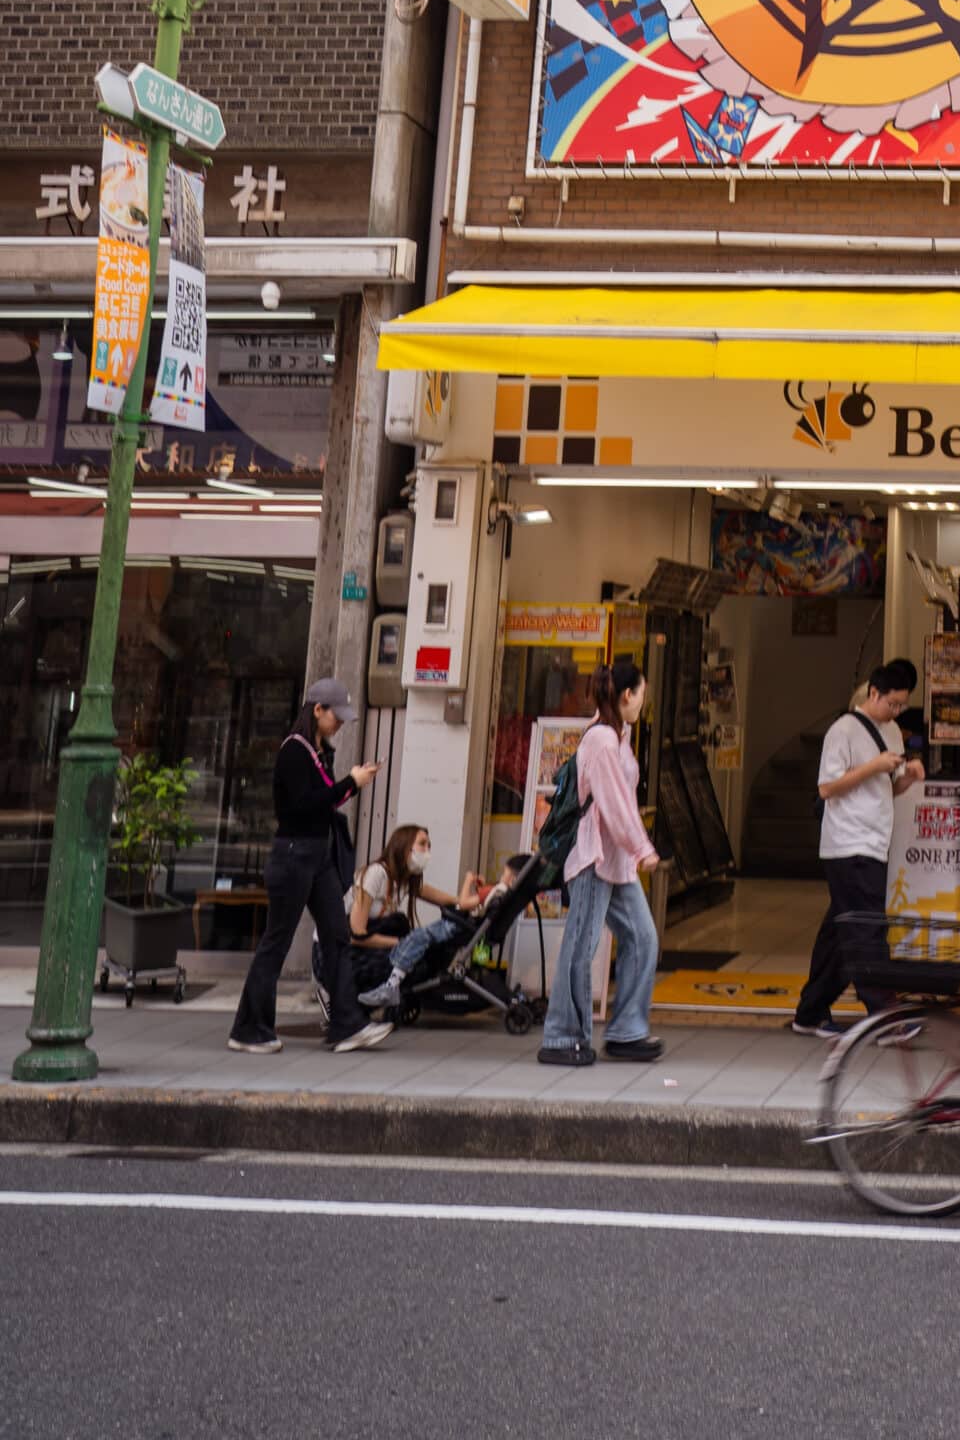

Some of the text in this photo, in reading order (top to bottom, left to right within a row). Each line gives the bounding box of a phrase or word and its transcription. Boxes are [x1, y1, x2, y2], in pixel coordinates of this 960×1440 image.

[99, 255, 149, 277] フードホール
[98, 276, 148, 295] Food Court
[416, 670, 448, 681] SECOM
[906, 846, 943, 864] ONE
